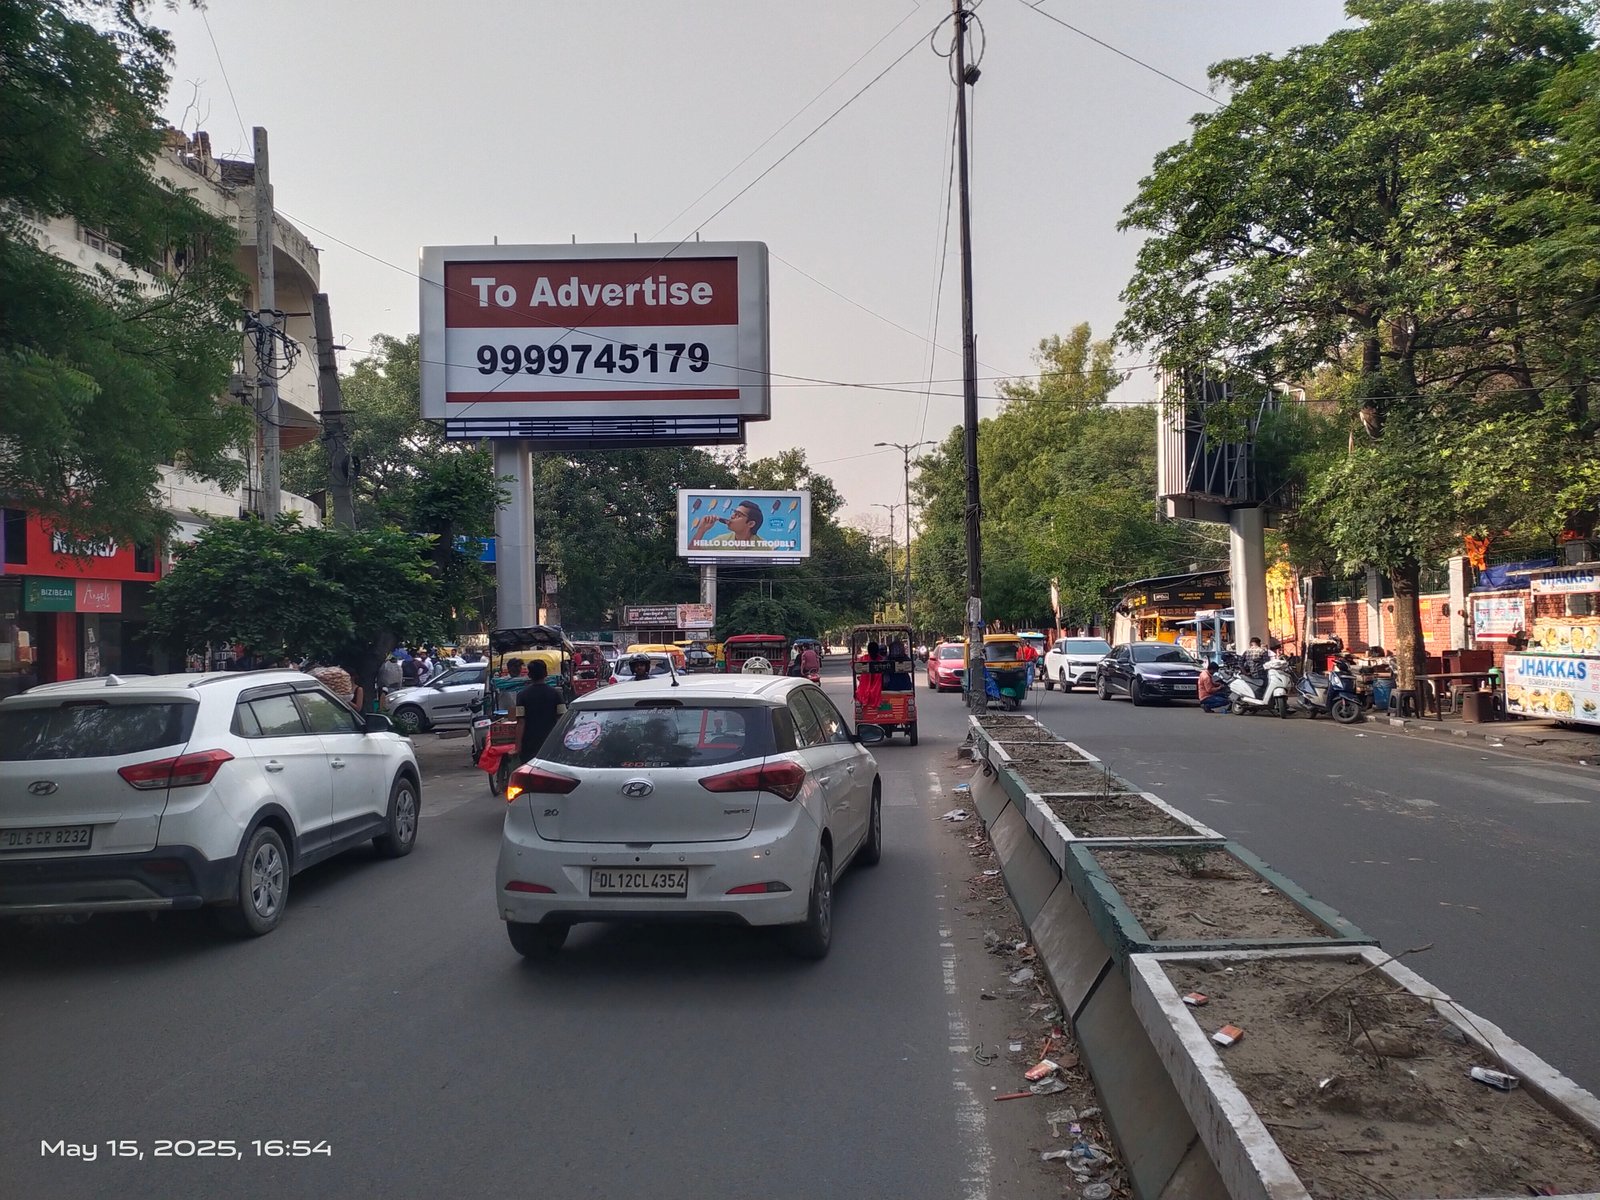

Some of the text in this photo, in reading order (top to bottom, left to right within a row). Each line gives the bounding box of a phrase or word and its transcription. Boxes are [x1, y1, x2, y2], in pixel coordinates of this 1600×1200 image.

[471, 275, 713, 308] To Advertise
[476, 342, 710, 375] 9999745179
[693, 539, 720, 547] HELLO
[722, 539, 755, 547] DOUBLE
[1541, 570, 1594, 585] JHAKKAS
[41, 588, 73, 597] BIZIBEAN
[1518, 658, 1587, 680] JHAKKAS
[600, 873, 685, 889] DL12CL4354
